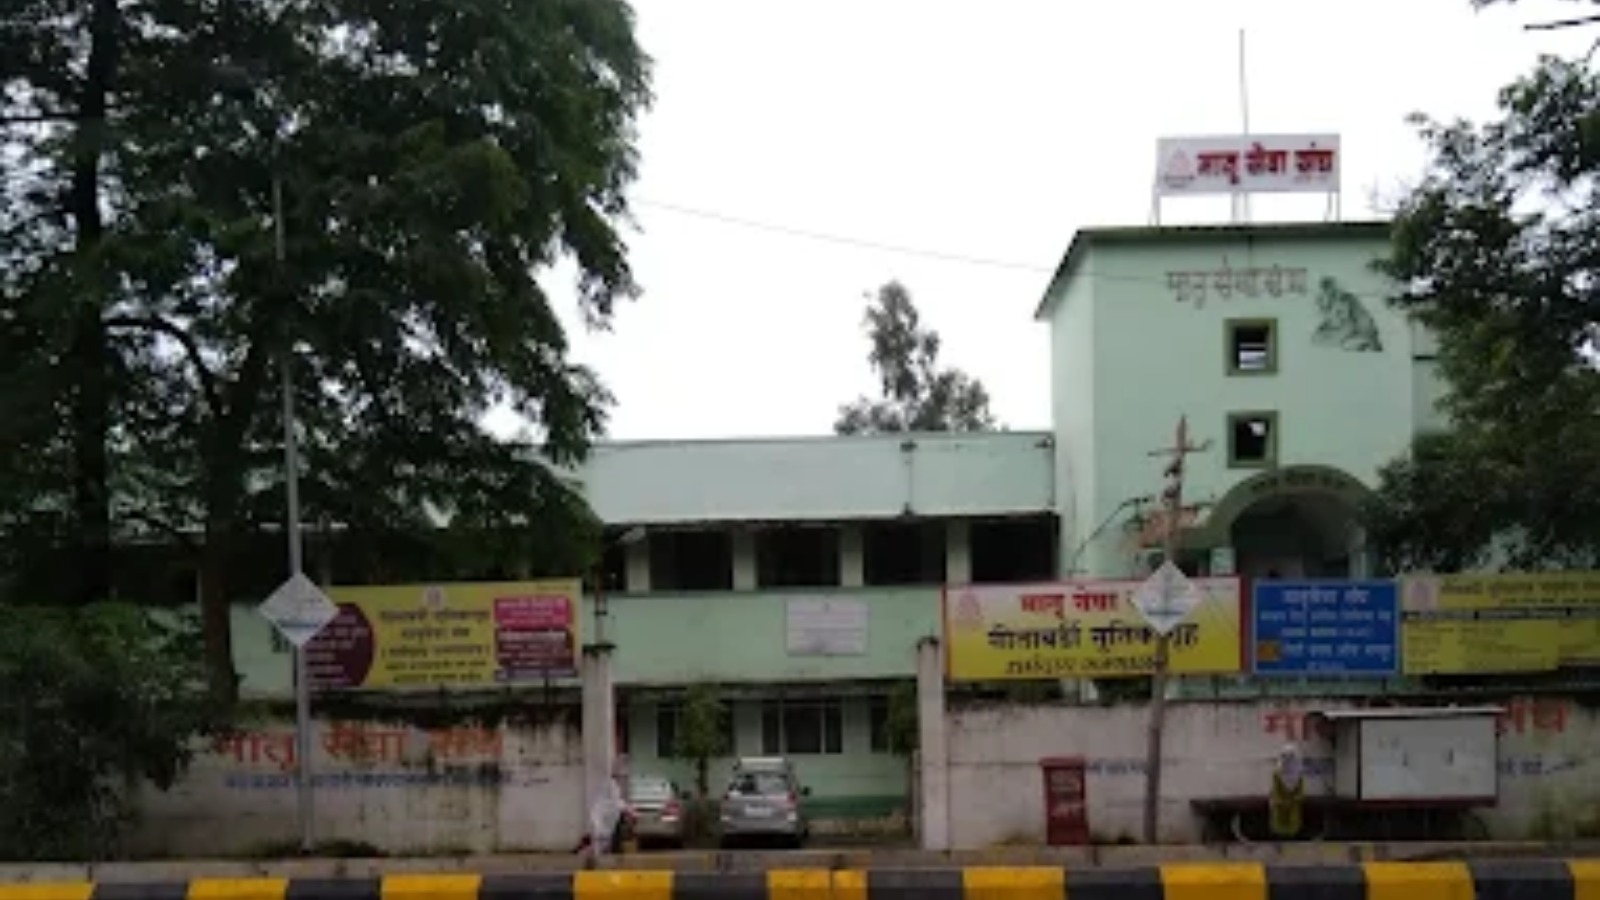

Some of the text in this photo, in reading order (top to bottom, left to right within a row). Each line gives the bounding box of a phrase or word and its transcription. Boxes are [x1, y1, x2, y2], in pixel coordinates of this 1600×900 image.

[1244, 142, 1289, 176] सेवा
[1293, 141, 1335, 172] संघ
[1071, 584, 1119, 611] सेवा
